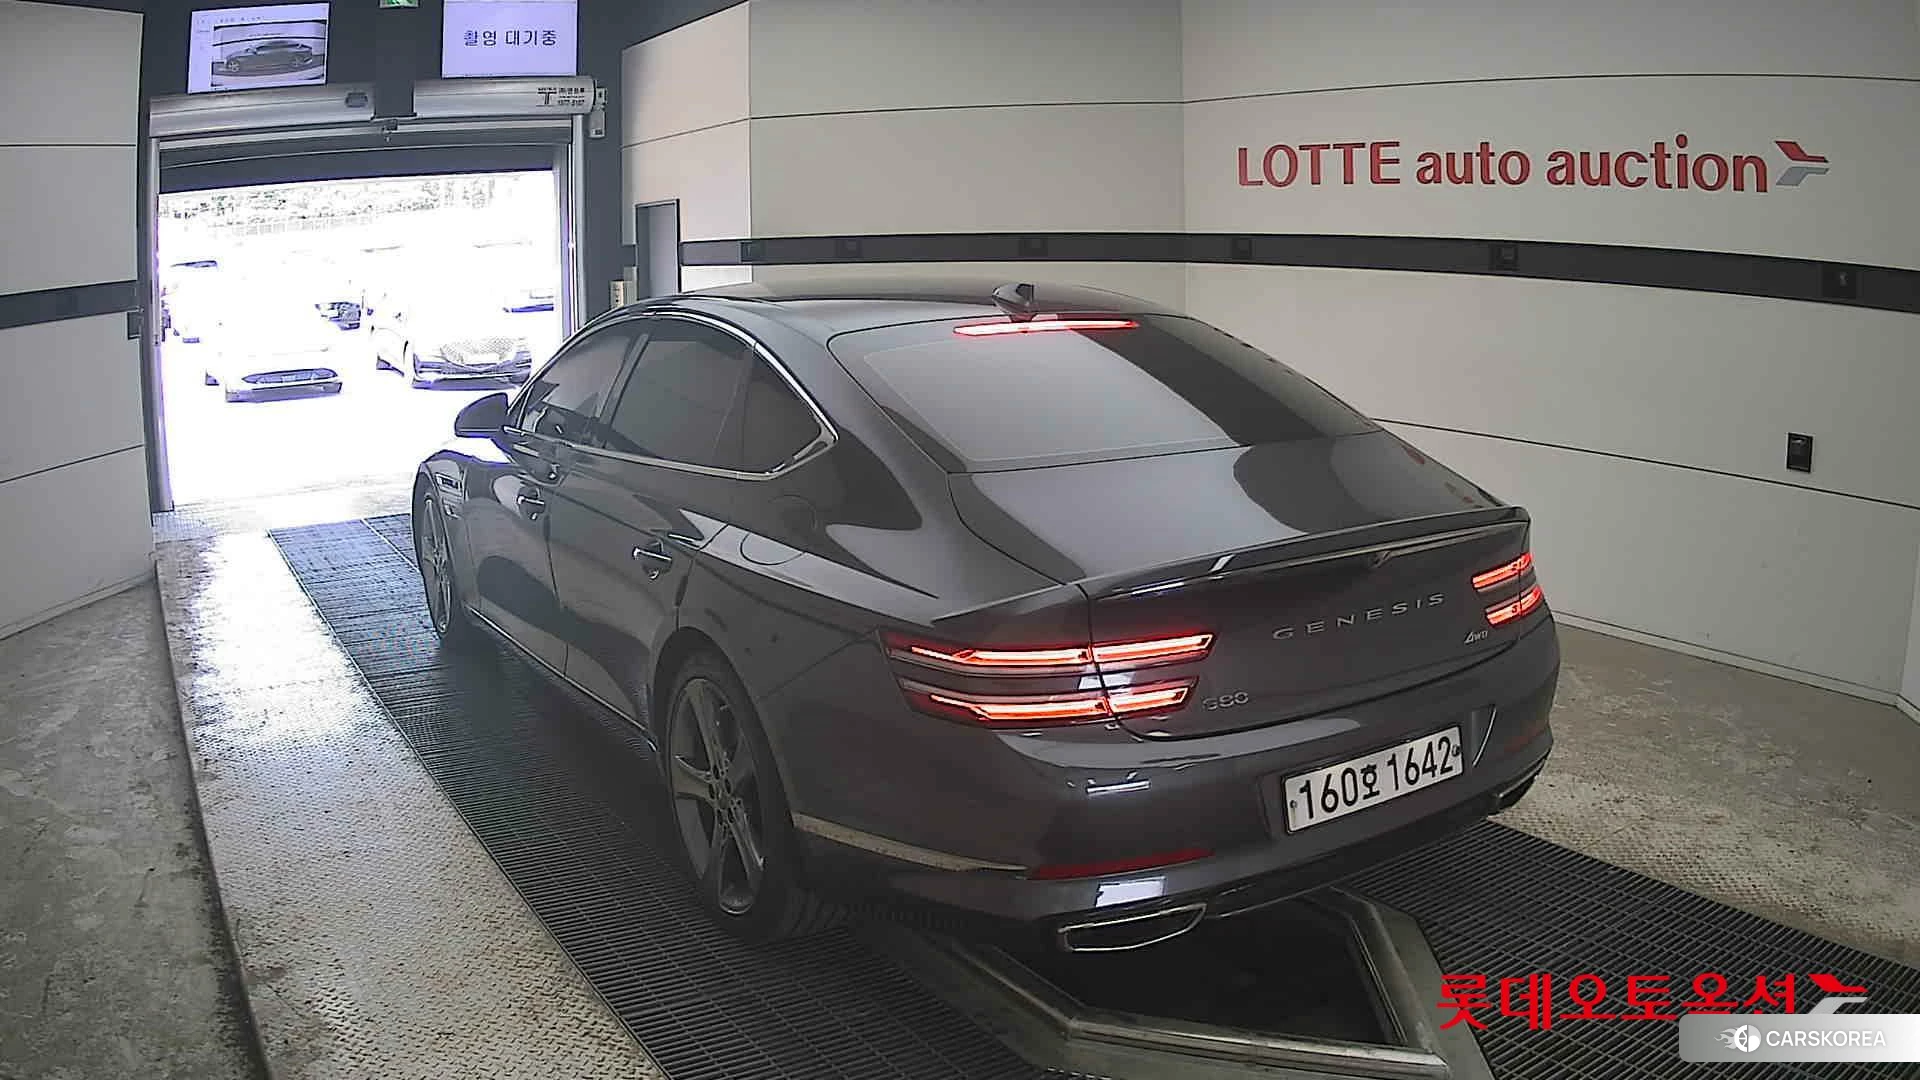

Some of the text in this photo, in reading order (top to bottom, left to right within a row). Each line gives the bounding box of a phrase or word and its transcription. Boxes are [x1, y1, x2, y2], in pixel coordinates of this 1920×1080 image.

[505, 30, 557, 46] 대기중
[1238, 133, 1768, 193] LOTTE auto auction
[1272, 592, 1445, 640] GENESIS
[1202, 691, 1249, 711] G80
[1387, 735, 1454, 791] 1642
